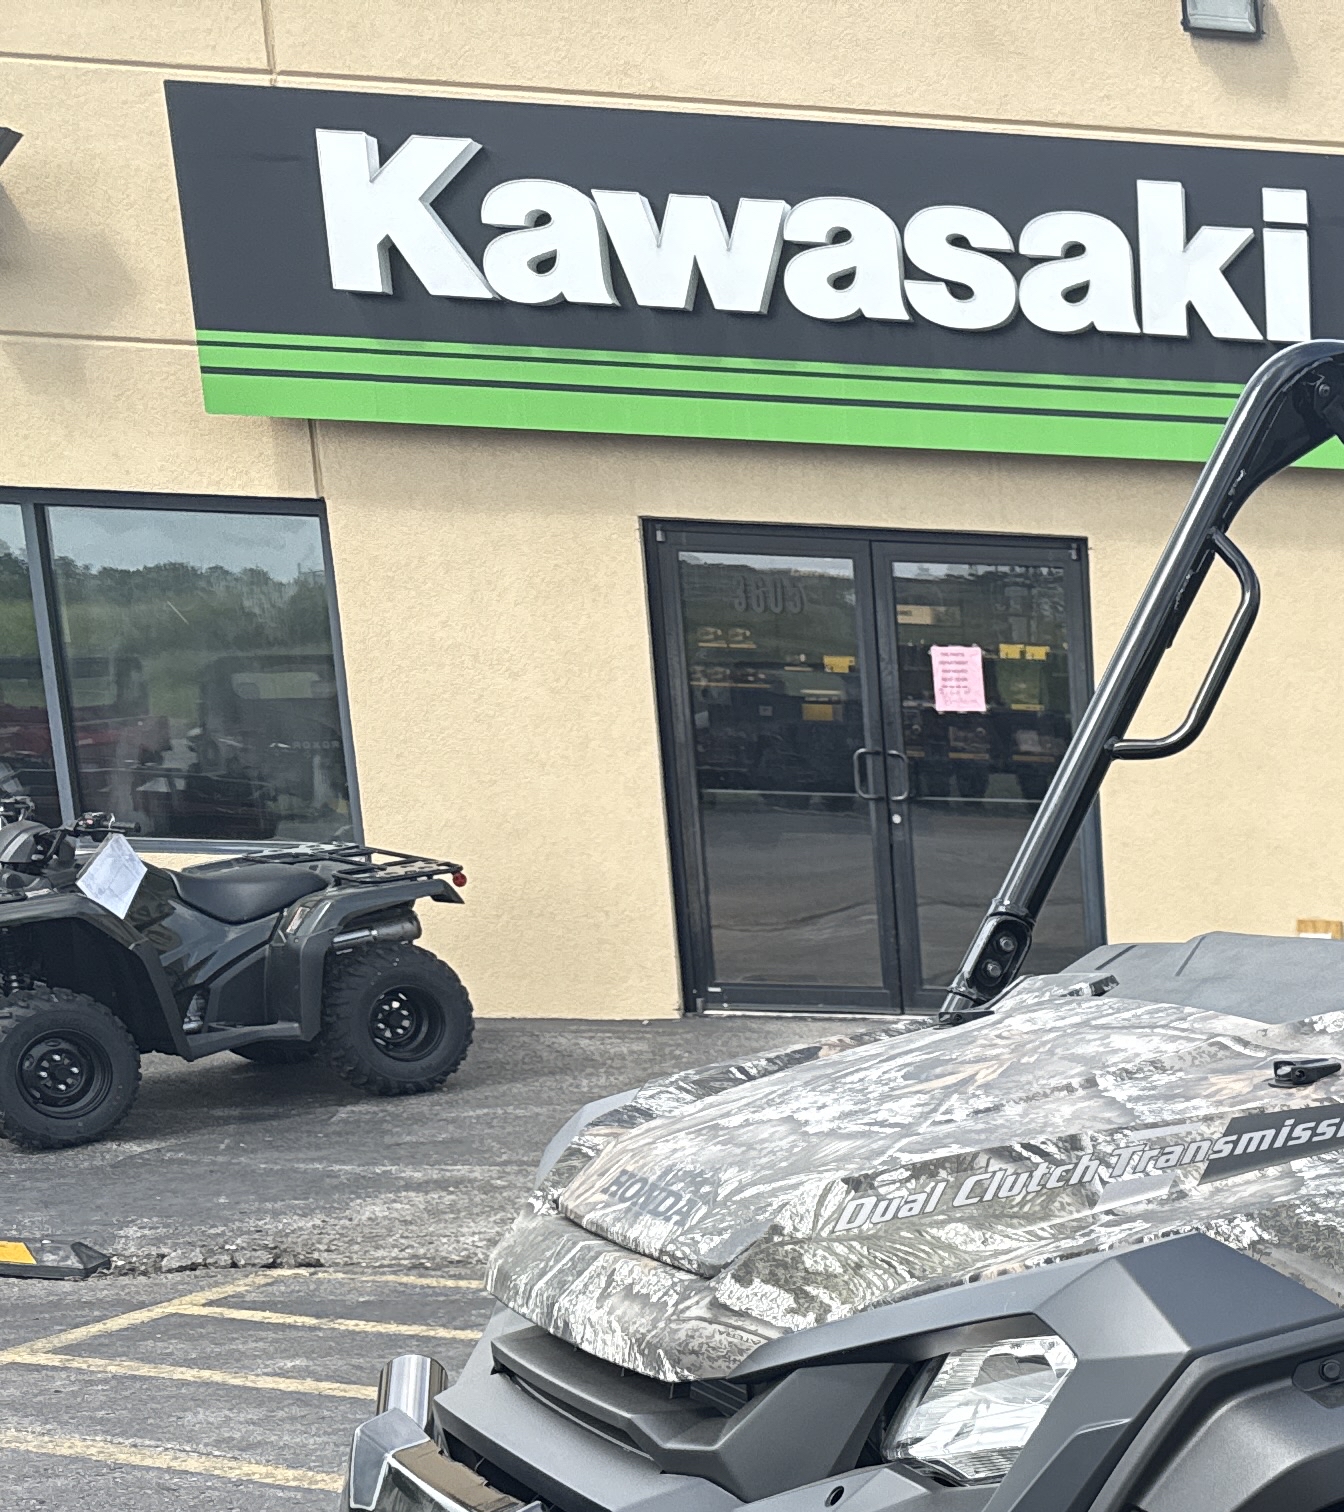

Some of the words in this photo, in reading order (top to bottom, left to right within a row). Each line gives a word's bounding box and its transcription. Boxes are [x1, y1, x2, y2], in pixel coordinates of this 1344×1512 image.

[315, 129, 1312, 343] Kawasaki
[600, 1168, 701, 1227] HONDA
[832, 1184, 943, 1235] Dual
[952, 1154, 1104, 1208] Clutch
